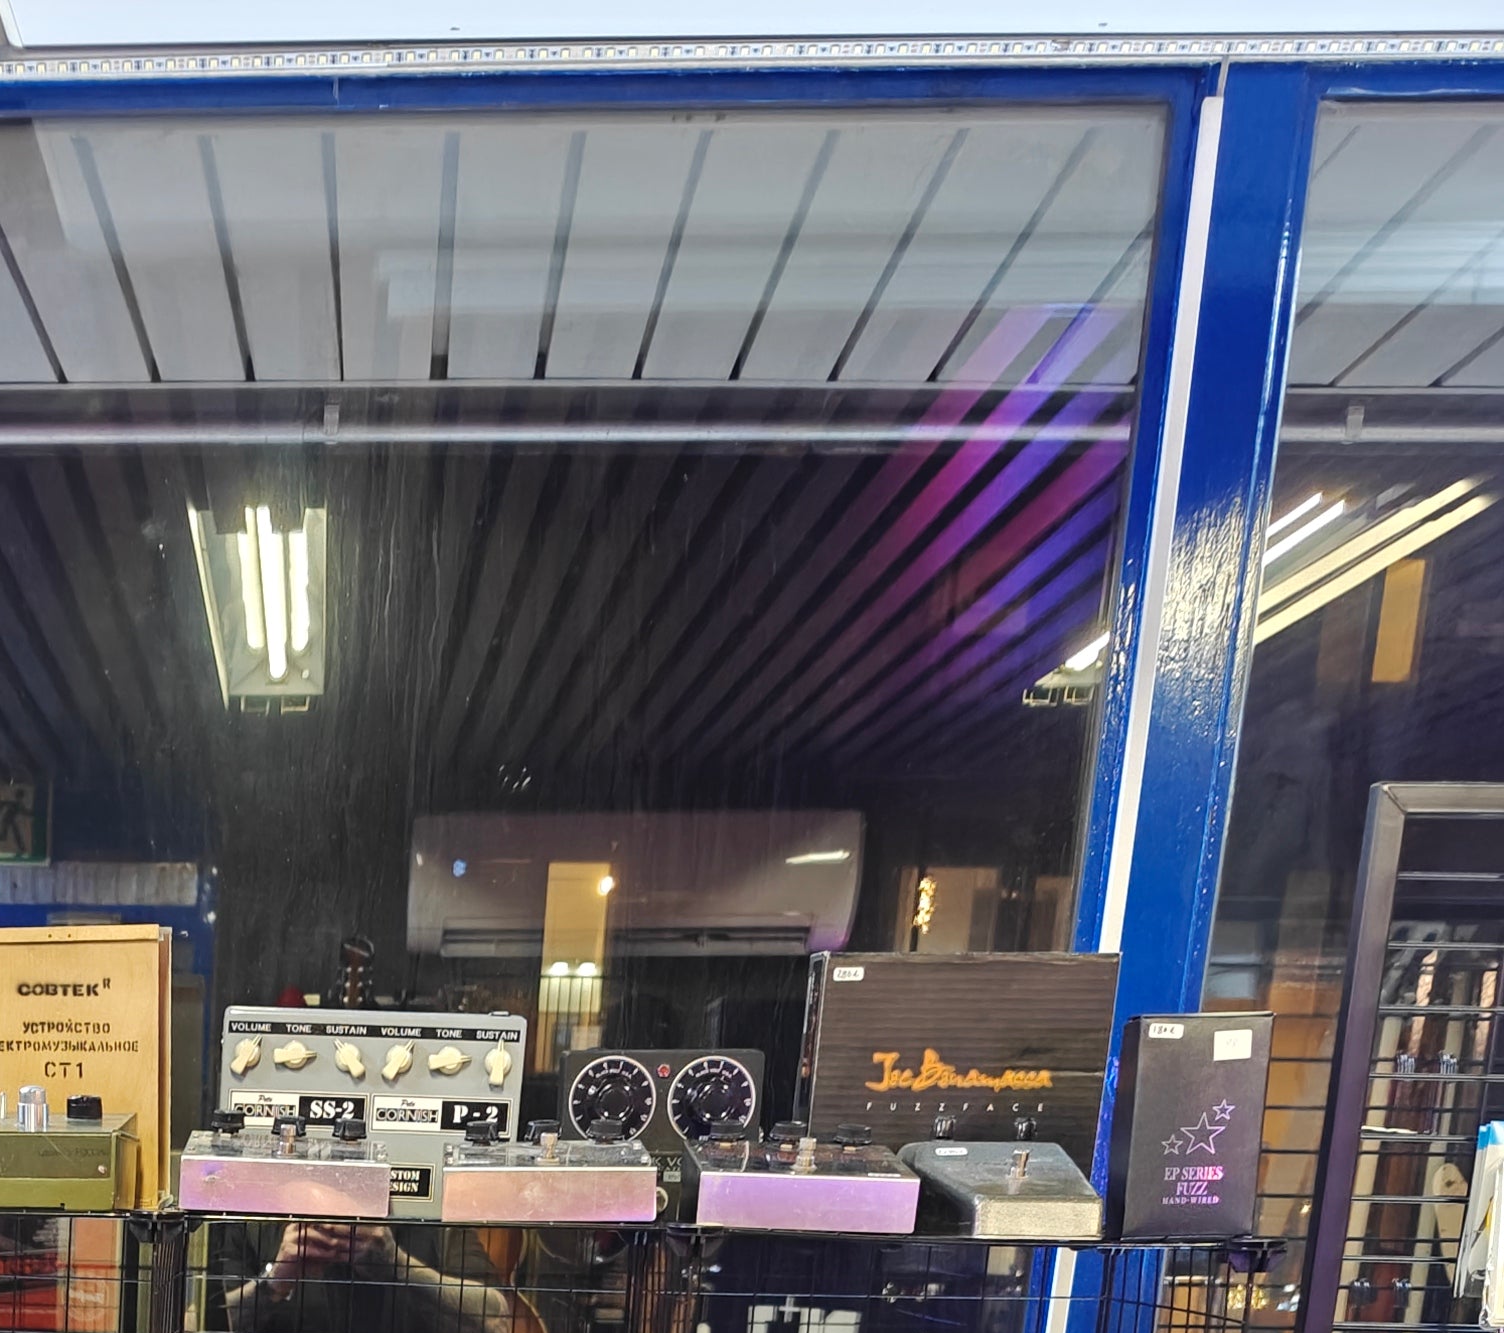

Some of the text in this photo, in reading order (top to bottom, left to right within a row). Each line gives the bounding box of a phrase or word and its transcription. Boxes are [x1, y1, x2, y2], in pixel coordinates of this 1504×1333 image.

[23, 1019, 111, 1034] УСТРОЙСТВО
[231, 1022, 518, 1040] VOLUME TONE SUSTAIN VOLUME TONE SUSTAIN
[235, 1100, 355, 1119] CORNISH SS-2
[376, 1109, 438, 1123] CORNISH
[390, 1170, 421, 1181] STOM
[1164, 1166, 1224, 1180] EP SERIES
[390, 1182, 419, 1194] SIGN
[1177, 1182, 1208, 1195] FUZZ
